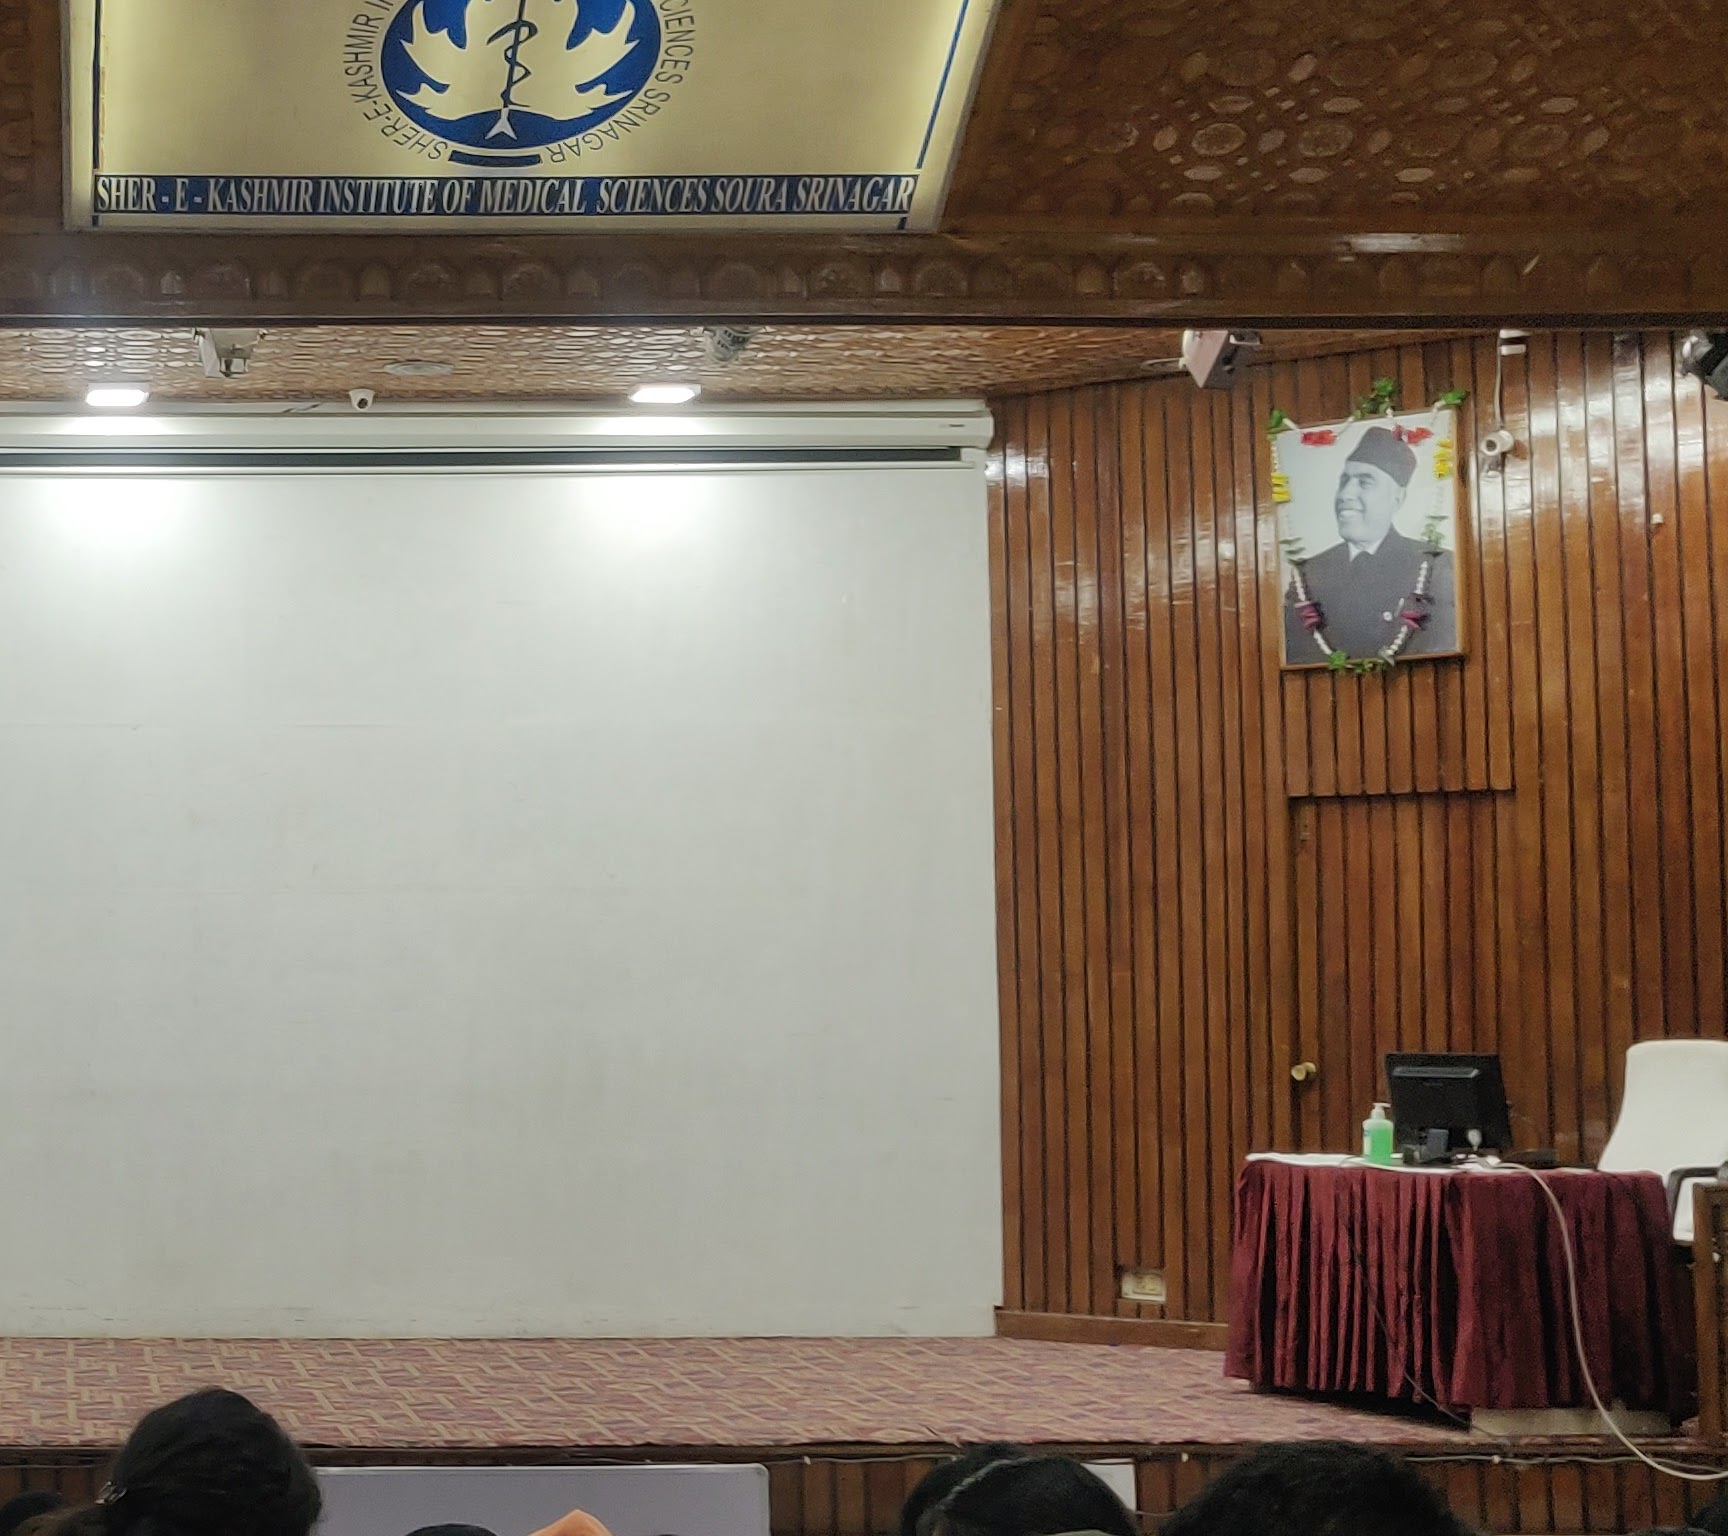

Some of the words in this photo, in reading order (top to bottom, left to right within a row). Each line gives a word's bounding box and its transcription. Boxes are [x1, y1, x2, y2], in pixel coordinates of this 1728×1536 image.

[545, 87, 671, 165] SRINAGAR
[97, 176, 157, 212] SHER
[206, 177, 313, 214] KASHMIR
[317, 178, 439, 214] INSTITUTE
[441, 178, 476, 214] OF
[478, 178, 588, 214] MEDICAL
[595, 177, 708, 214] SCIENCES
[712, 177, 789, 213] SOURA
[792, 175, 916, 213] SRINAGAR
